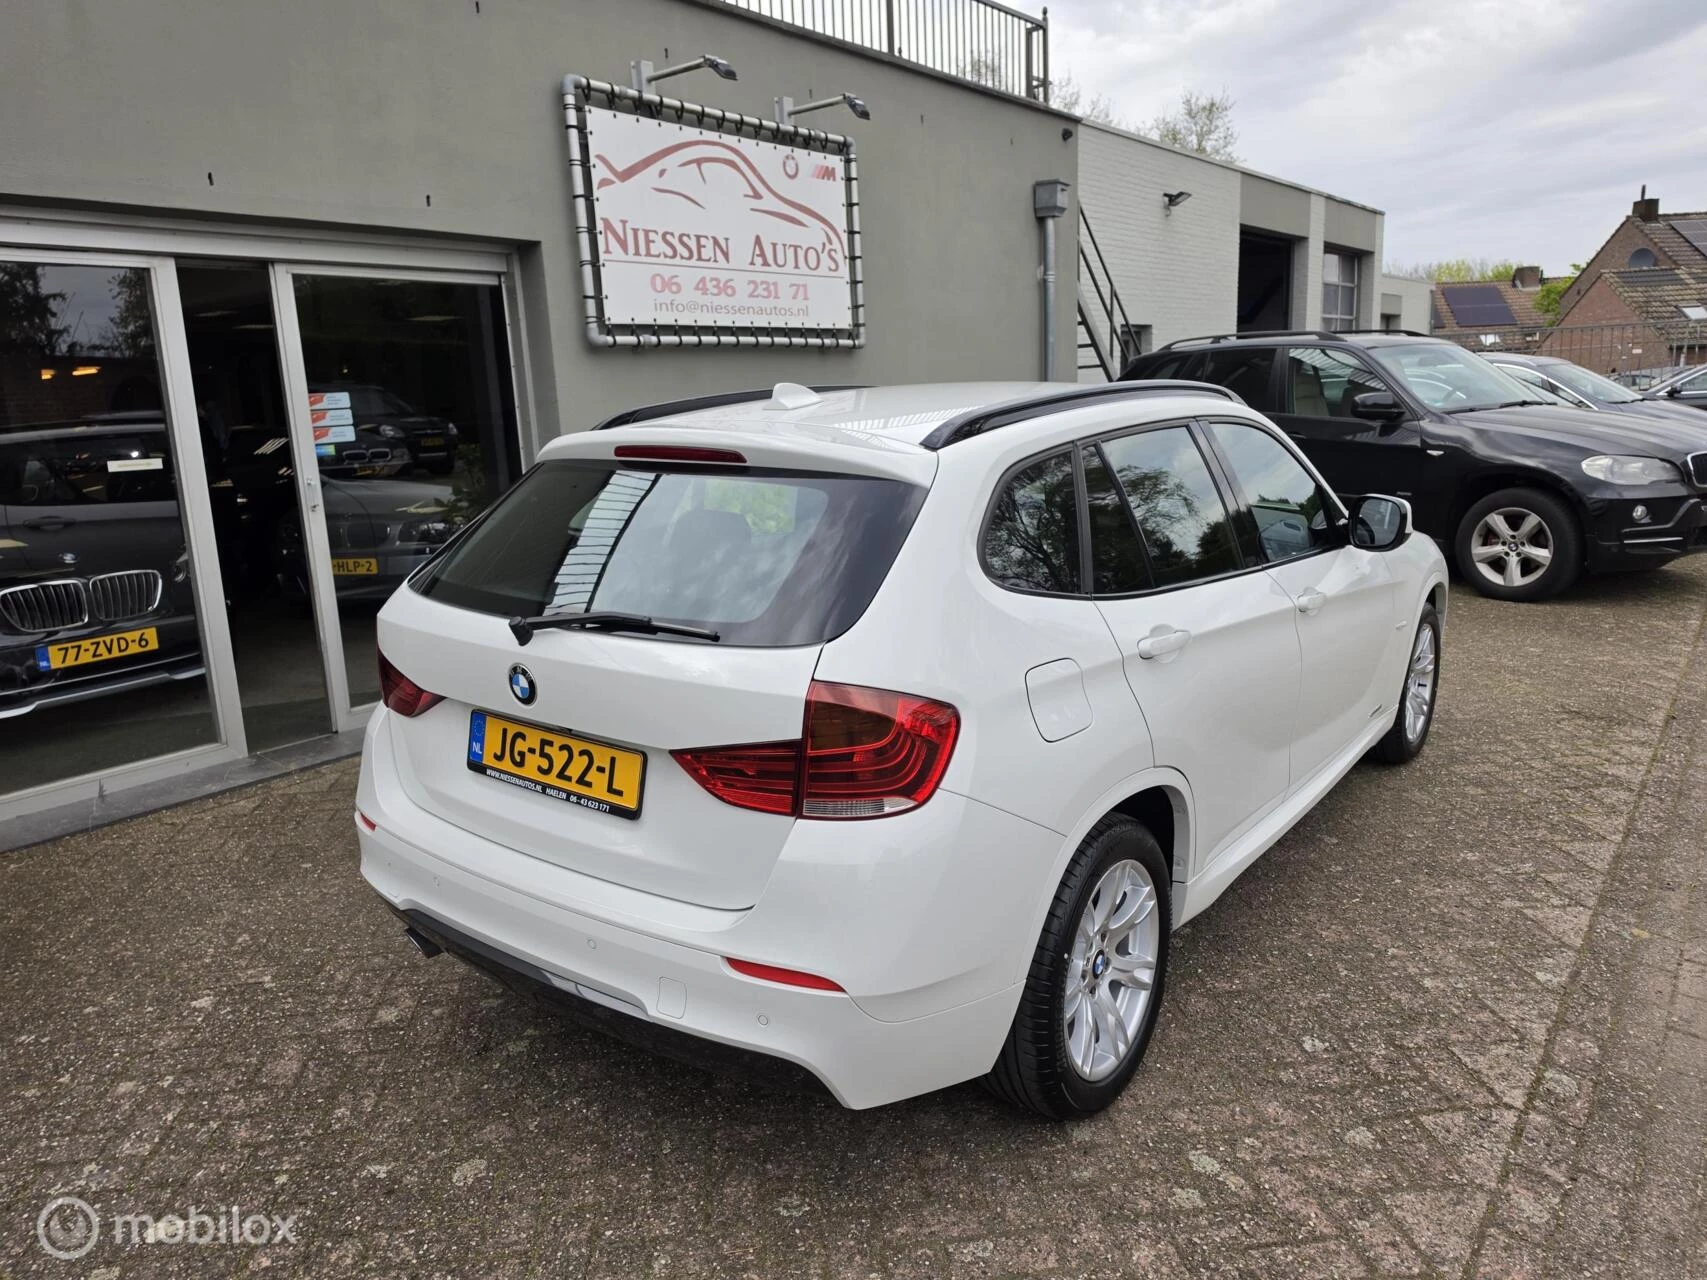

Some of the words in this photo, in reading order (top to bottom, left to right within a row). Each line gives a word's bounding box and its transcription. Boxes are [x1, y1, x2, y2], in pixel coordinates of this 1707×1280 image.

[600, 217, 731, 265] NIESSEN
[748, 234, 840, 272] AUTO'S
[650, 273, 682, 295] 06
[694, 277, 736, 297] 436
[747, 280, 780, 300] 231
[789, 283, 810, 301] 71
[653, 299, 810, 318] info@niessenautos.nl
[57, 632, 149, 664] 77-ZVD-6
[472, 741, 483, 755] NL
[493, 727, 624, 797] JG-522-L
[486, 768, 543, 793] WWW.NIESSENAUTOS.NL
